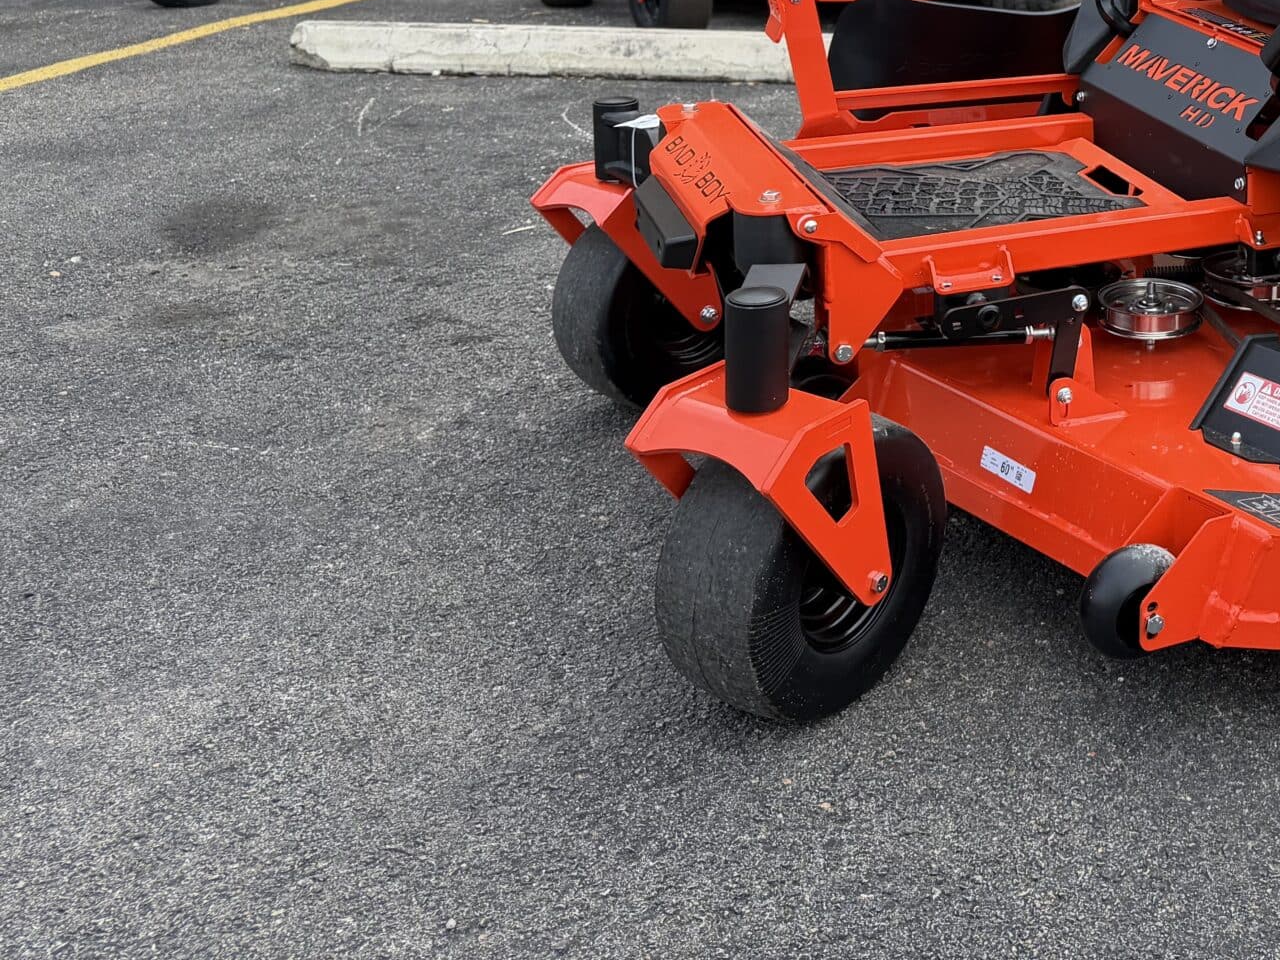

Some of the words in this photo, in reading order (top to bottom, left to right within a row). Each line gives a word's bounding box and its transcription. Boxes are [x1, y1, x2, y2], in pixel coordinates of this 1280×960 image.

[1116, 43, 1260, 122] MAVERICK
[1178, 104, 1216, 129] HD
[665, 135, 696, 166] BAD
[695, 170, 731, 204] BOY
